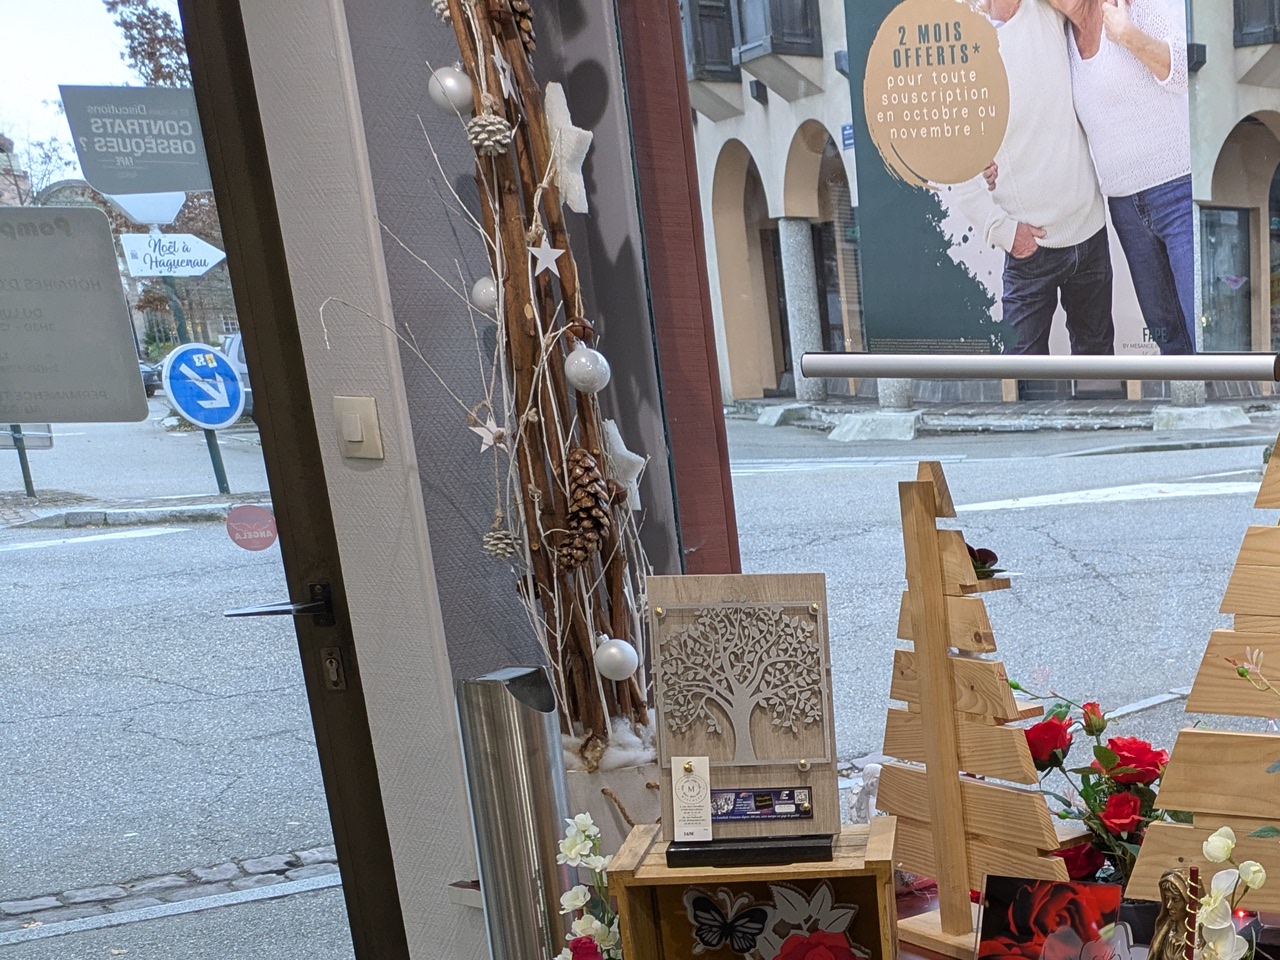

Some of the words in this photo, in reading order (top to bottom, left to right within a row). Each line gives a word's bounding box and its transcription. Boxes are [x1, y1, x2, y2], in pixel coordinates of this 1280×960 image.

[898, 25, 906, 46] 2
[918, 21, 962, 45] MOIS
[887, 73, 922, 90] pour
[931, 69, 976, 85] toute
[882, 86, 989, 105] souscription
[877, 110, 894, 122] en
[903, 104, 968, 121] octobre
[978, 105, 996, 117] ou
[890, 123, 971, 139] novembre
[148, 238, 180, 257] Noël
[182, 241, 191, 253] à
[143, 253, 209, 273] Haguenau
[1143, 327, 1167, 343] FAPE
